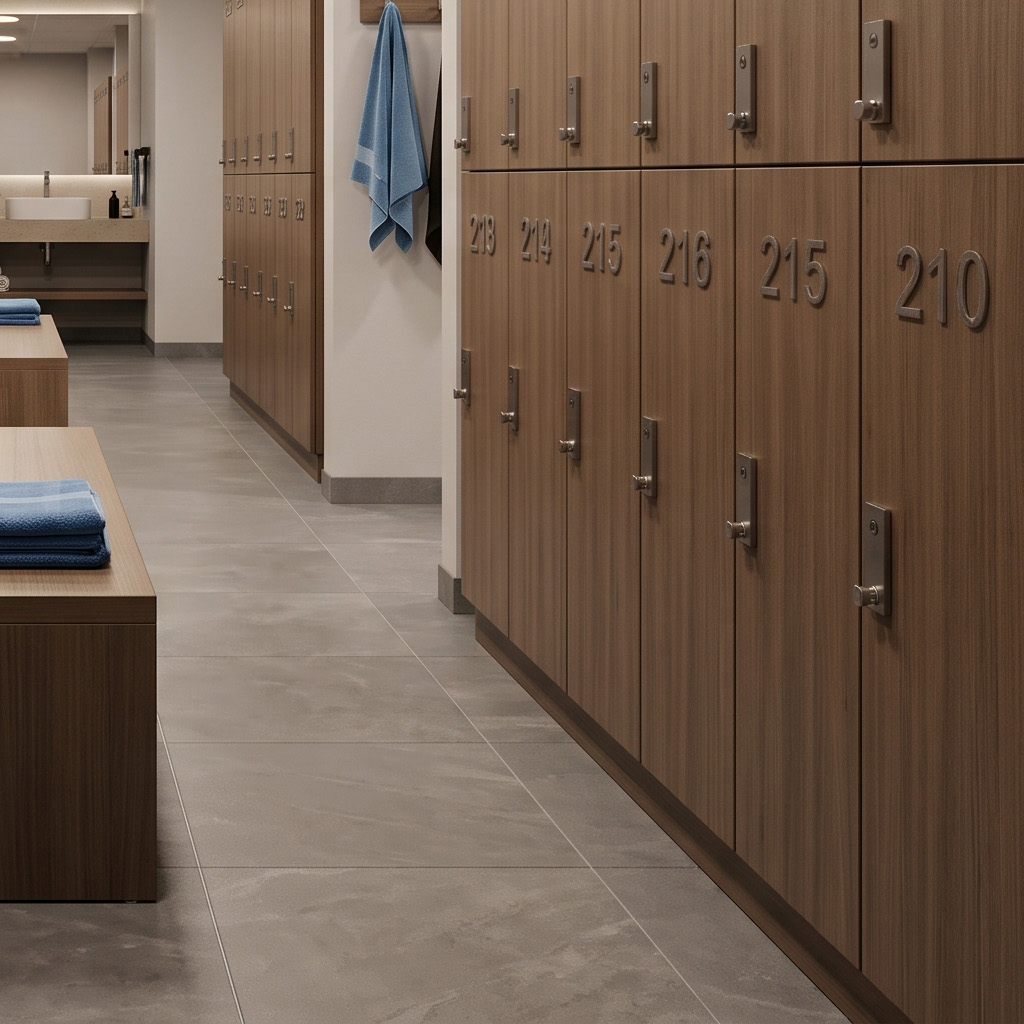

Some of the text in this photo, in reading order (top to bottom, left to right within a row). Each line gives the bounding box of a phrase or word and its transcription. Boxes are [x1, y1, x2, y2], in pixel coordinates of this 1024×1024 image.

[521, 217, 552, 264] 214
[582, 221, 622, 276] 215
[658, 228, 711, 289] 216
[760, 234, 827, 307] 215
[894, 245, 991, 332] 210
